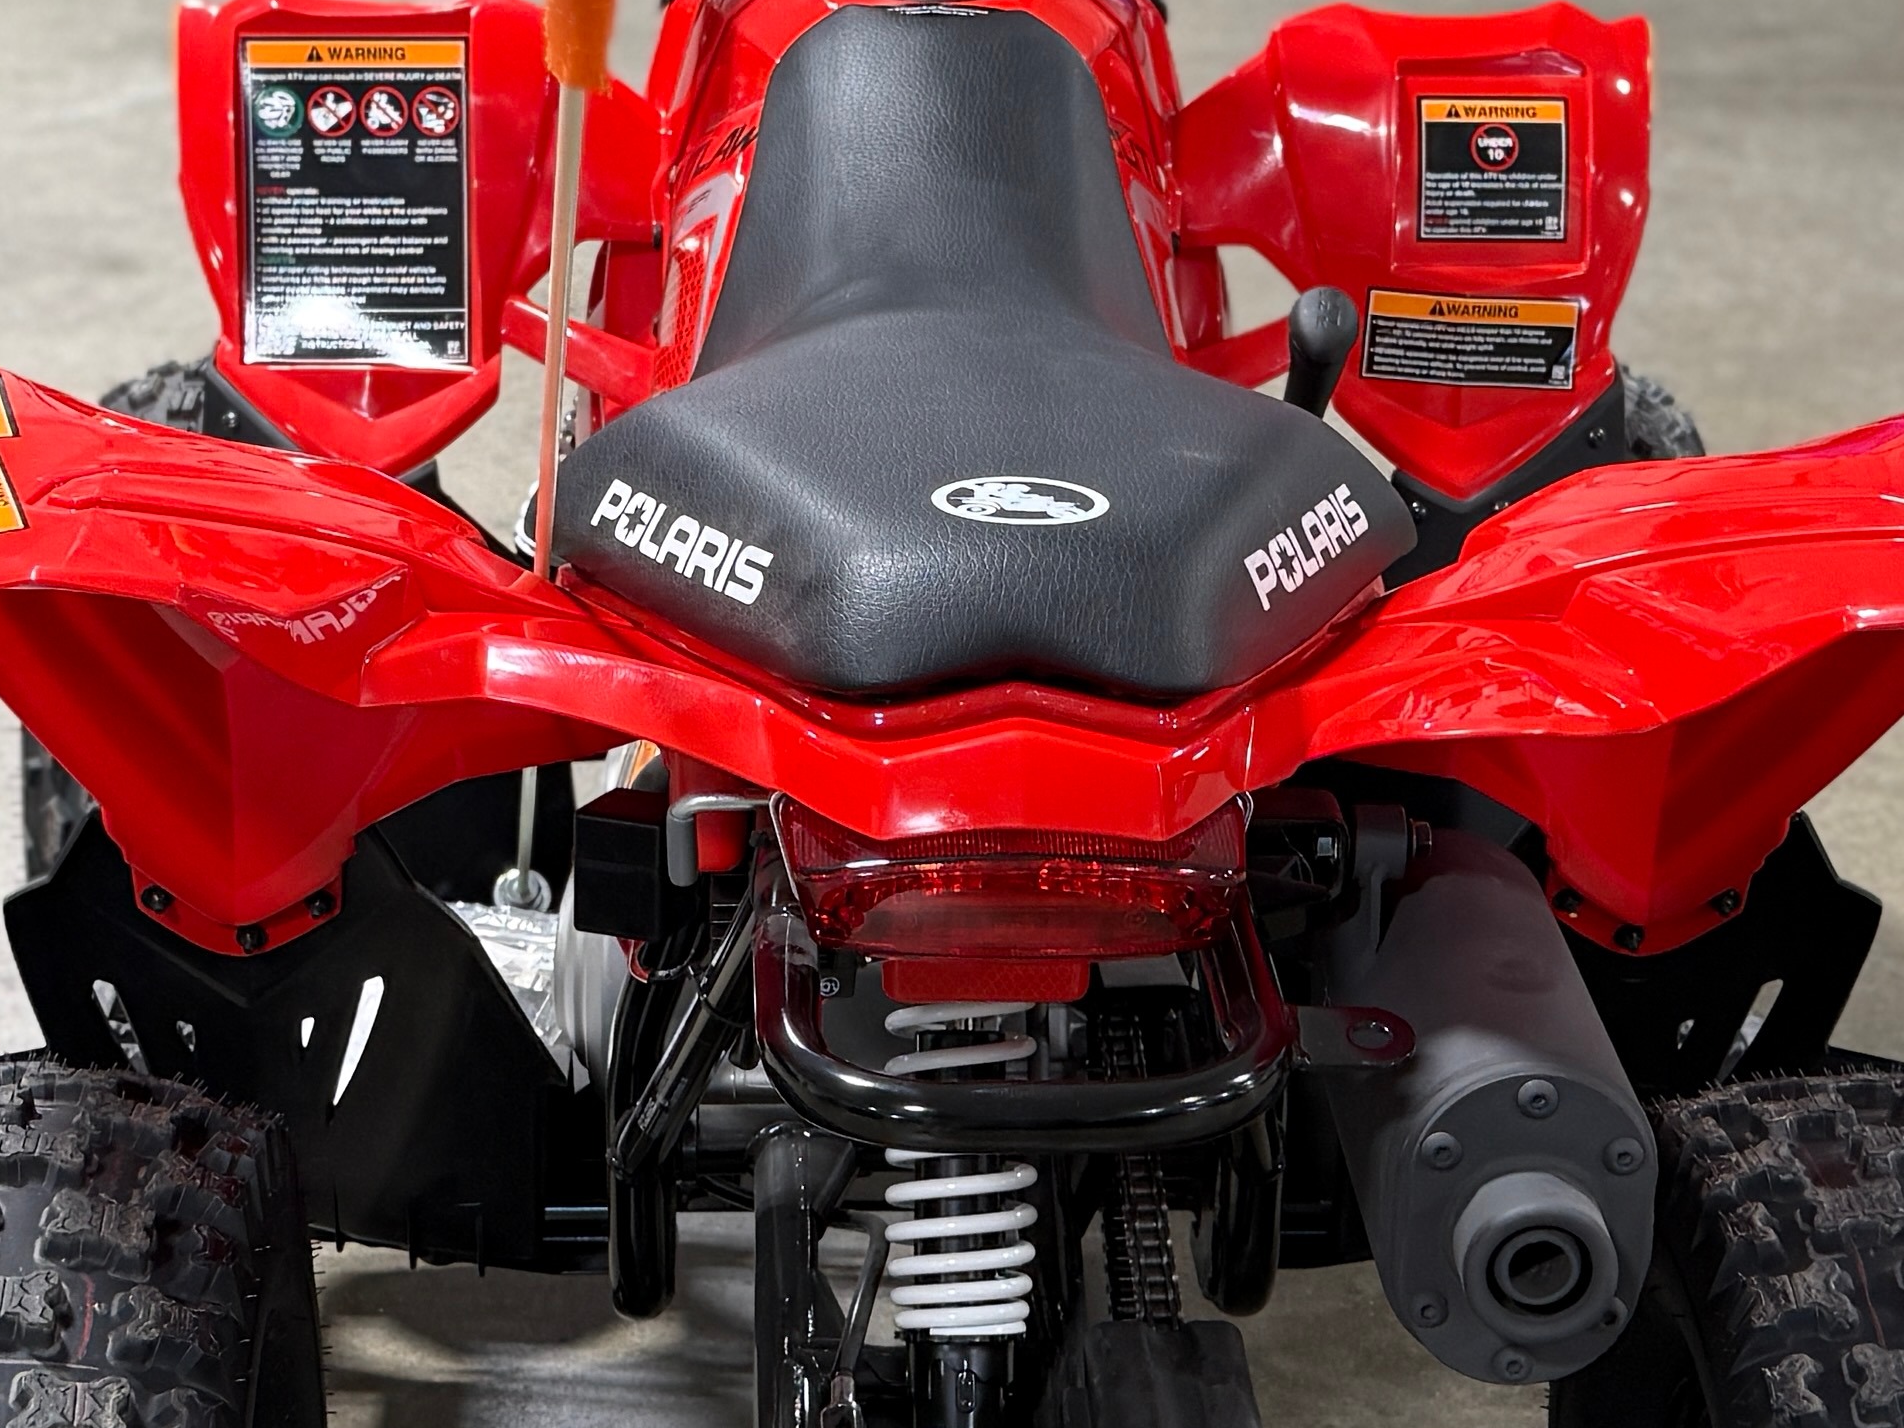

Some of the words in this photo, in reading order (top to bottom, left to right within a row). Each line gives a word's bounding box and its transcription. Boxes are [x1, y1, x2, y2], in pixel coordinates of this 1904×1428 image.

[327, 47, 406, 61] WARNING
[1462, 105, 1538, 119] WARNING
[1486, 148, 1505, 161] 10
[1446, 302, 1519, 320] WARNING
[590, 478, 774, 605] POLARIS
[1244, 483, 1369, 611] POLARIS
